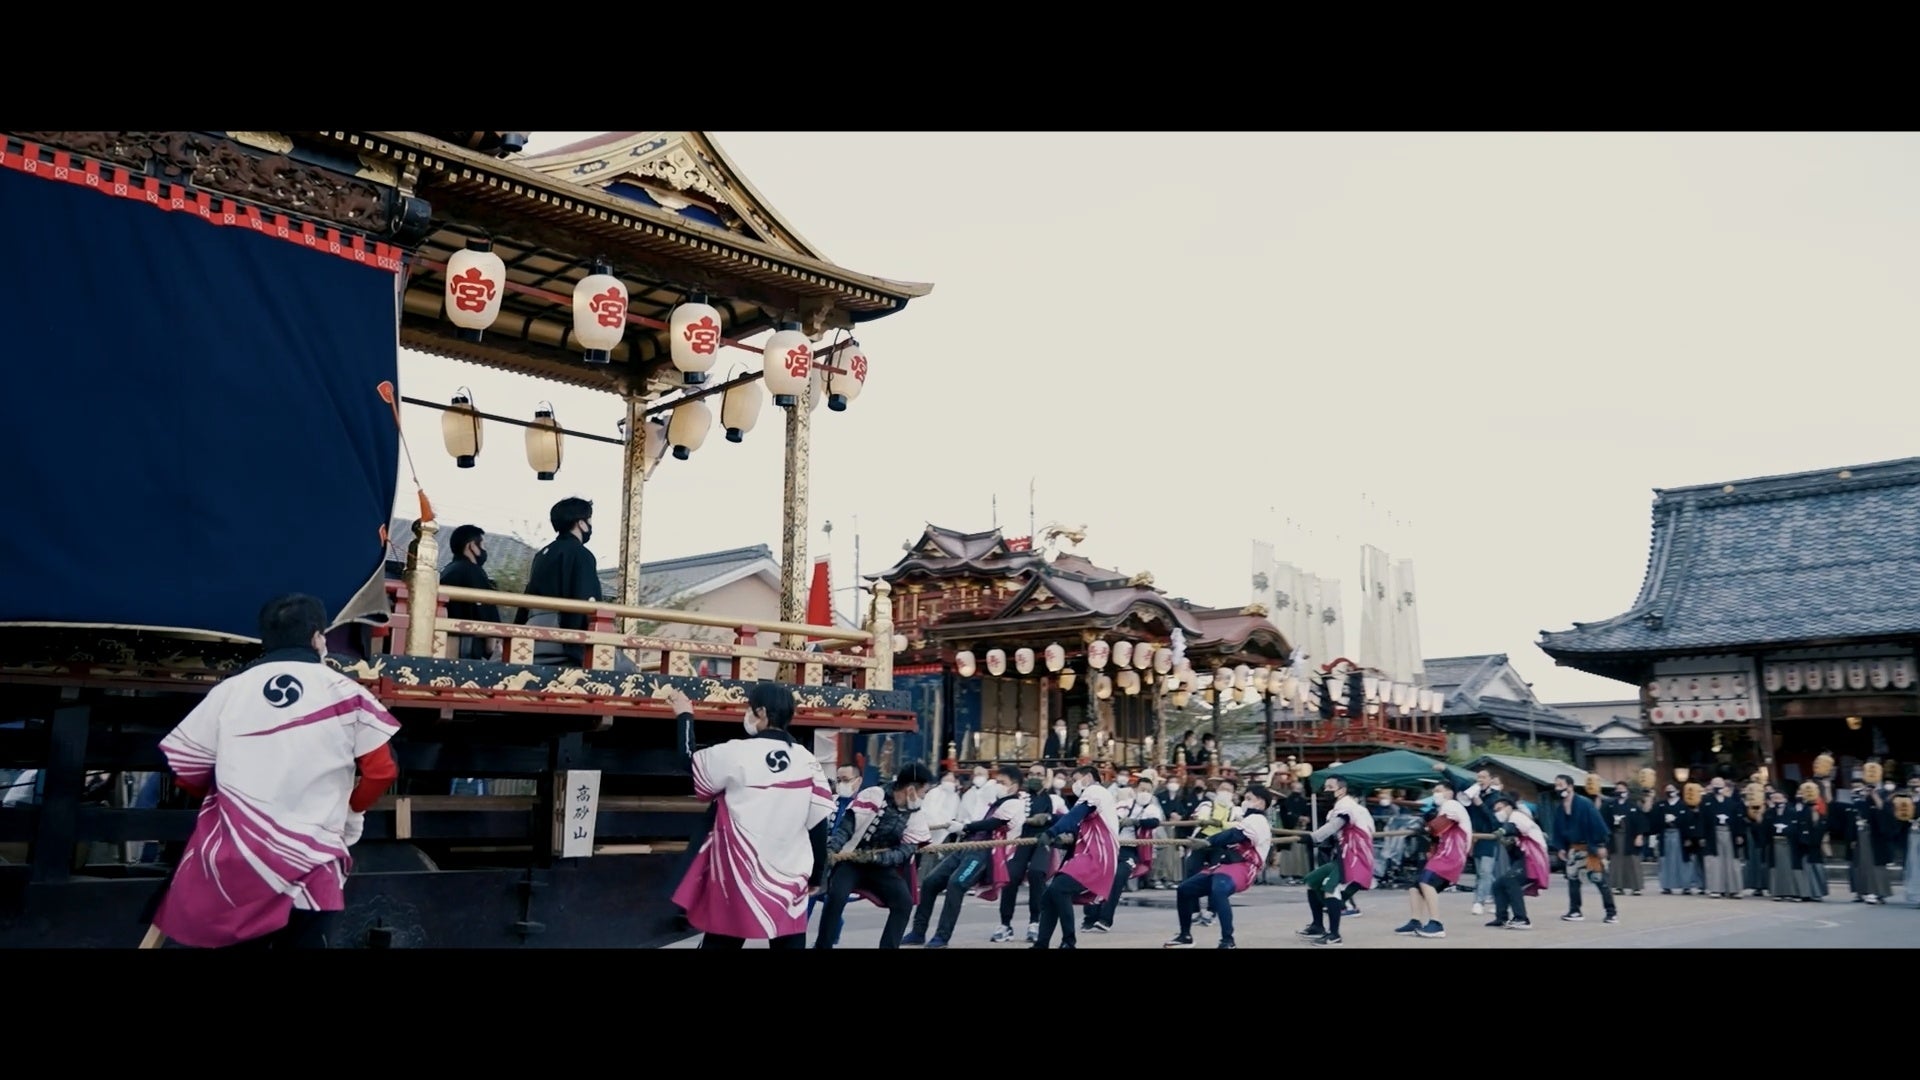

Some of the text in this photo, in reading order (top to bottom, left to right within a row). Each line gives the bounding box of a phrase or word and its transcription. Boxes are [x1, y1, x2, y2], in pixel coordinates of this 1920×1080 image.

[448, 267, 496, 314] 宮
[588, 286, 628, 329] 宮
[683, 315, 721, 356] 宮
[784, 343, 812, 379] 宮
[573, 784, 591, 840] 高砂山
